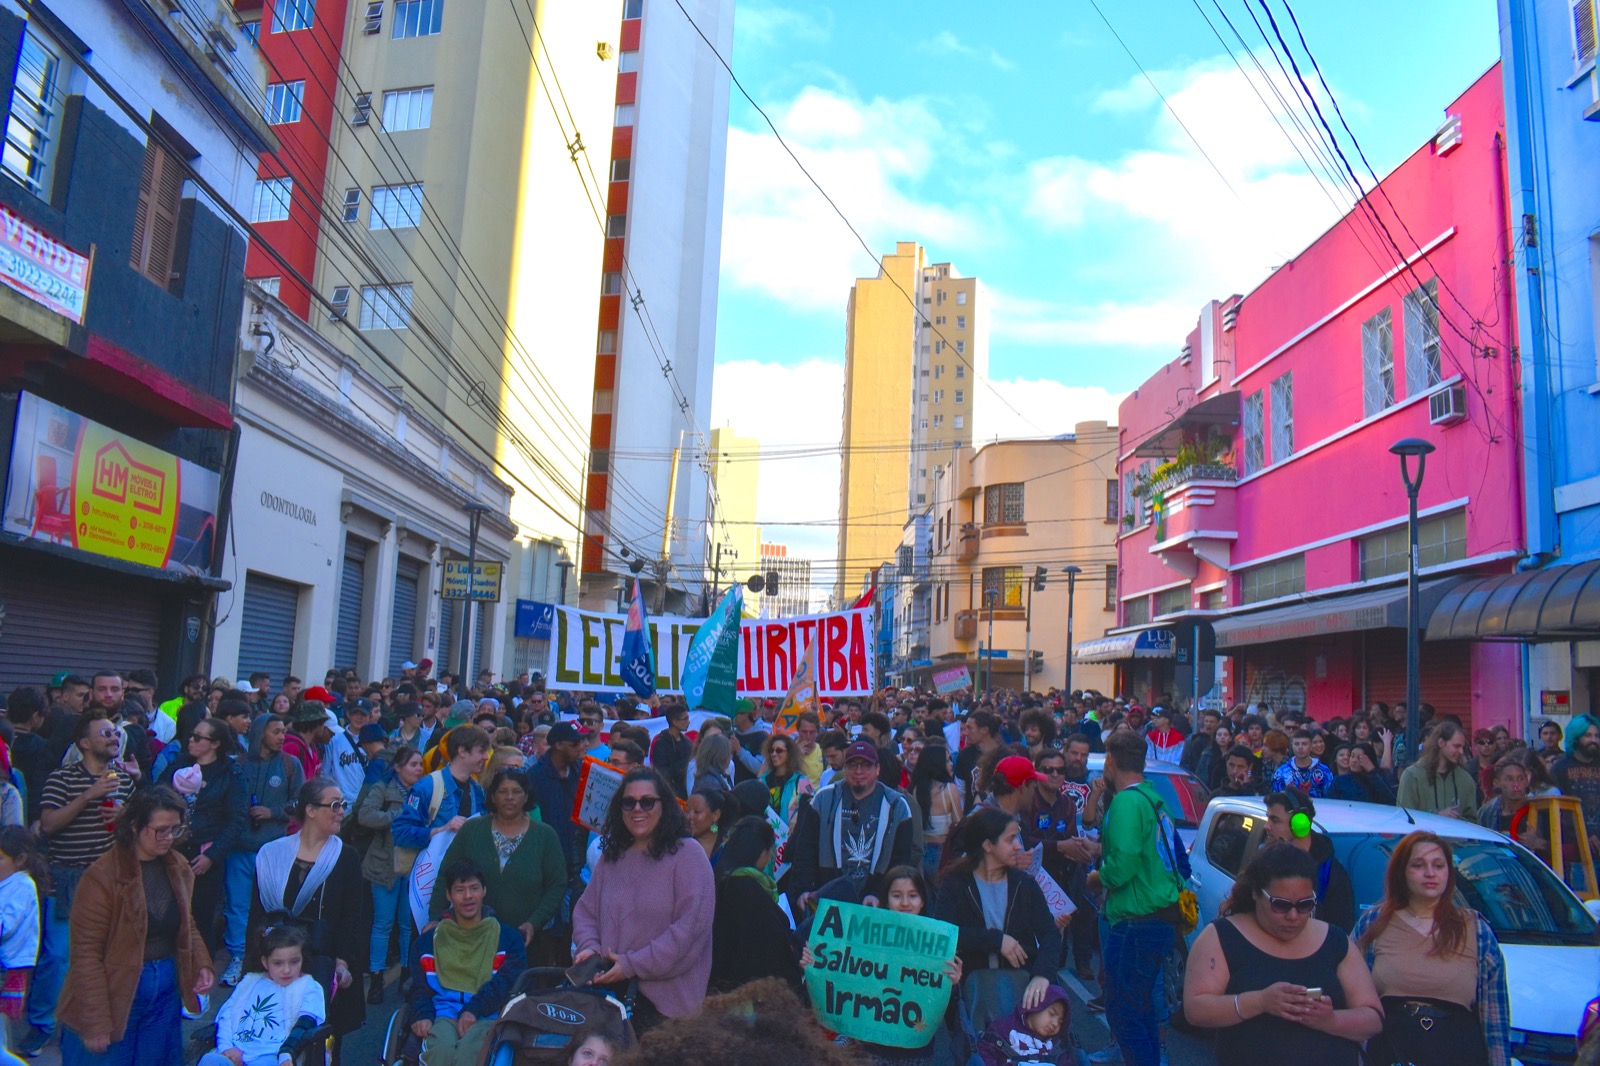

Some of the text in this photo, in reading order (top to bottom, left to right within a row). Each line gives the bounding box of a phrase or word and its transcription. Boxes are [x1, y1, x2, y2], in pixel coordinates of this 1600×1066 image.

[99, 457, 129, 490] HM
[130, 473, 153, 488] MÓVEIS
[129, 485, 157, 501] ELETROS
[260, 490, 317, 527] ODONTOLOGIA
[817, 905, 951, 958] A MACONHA
[812, 942, 944, 989] Salvou meu
[824, 979, 923, 1029] Irmão
